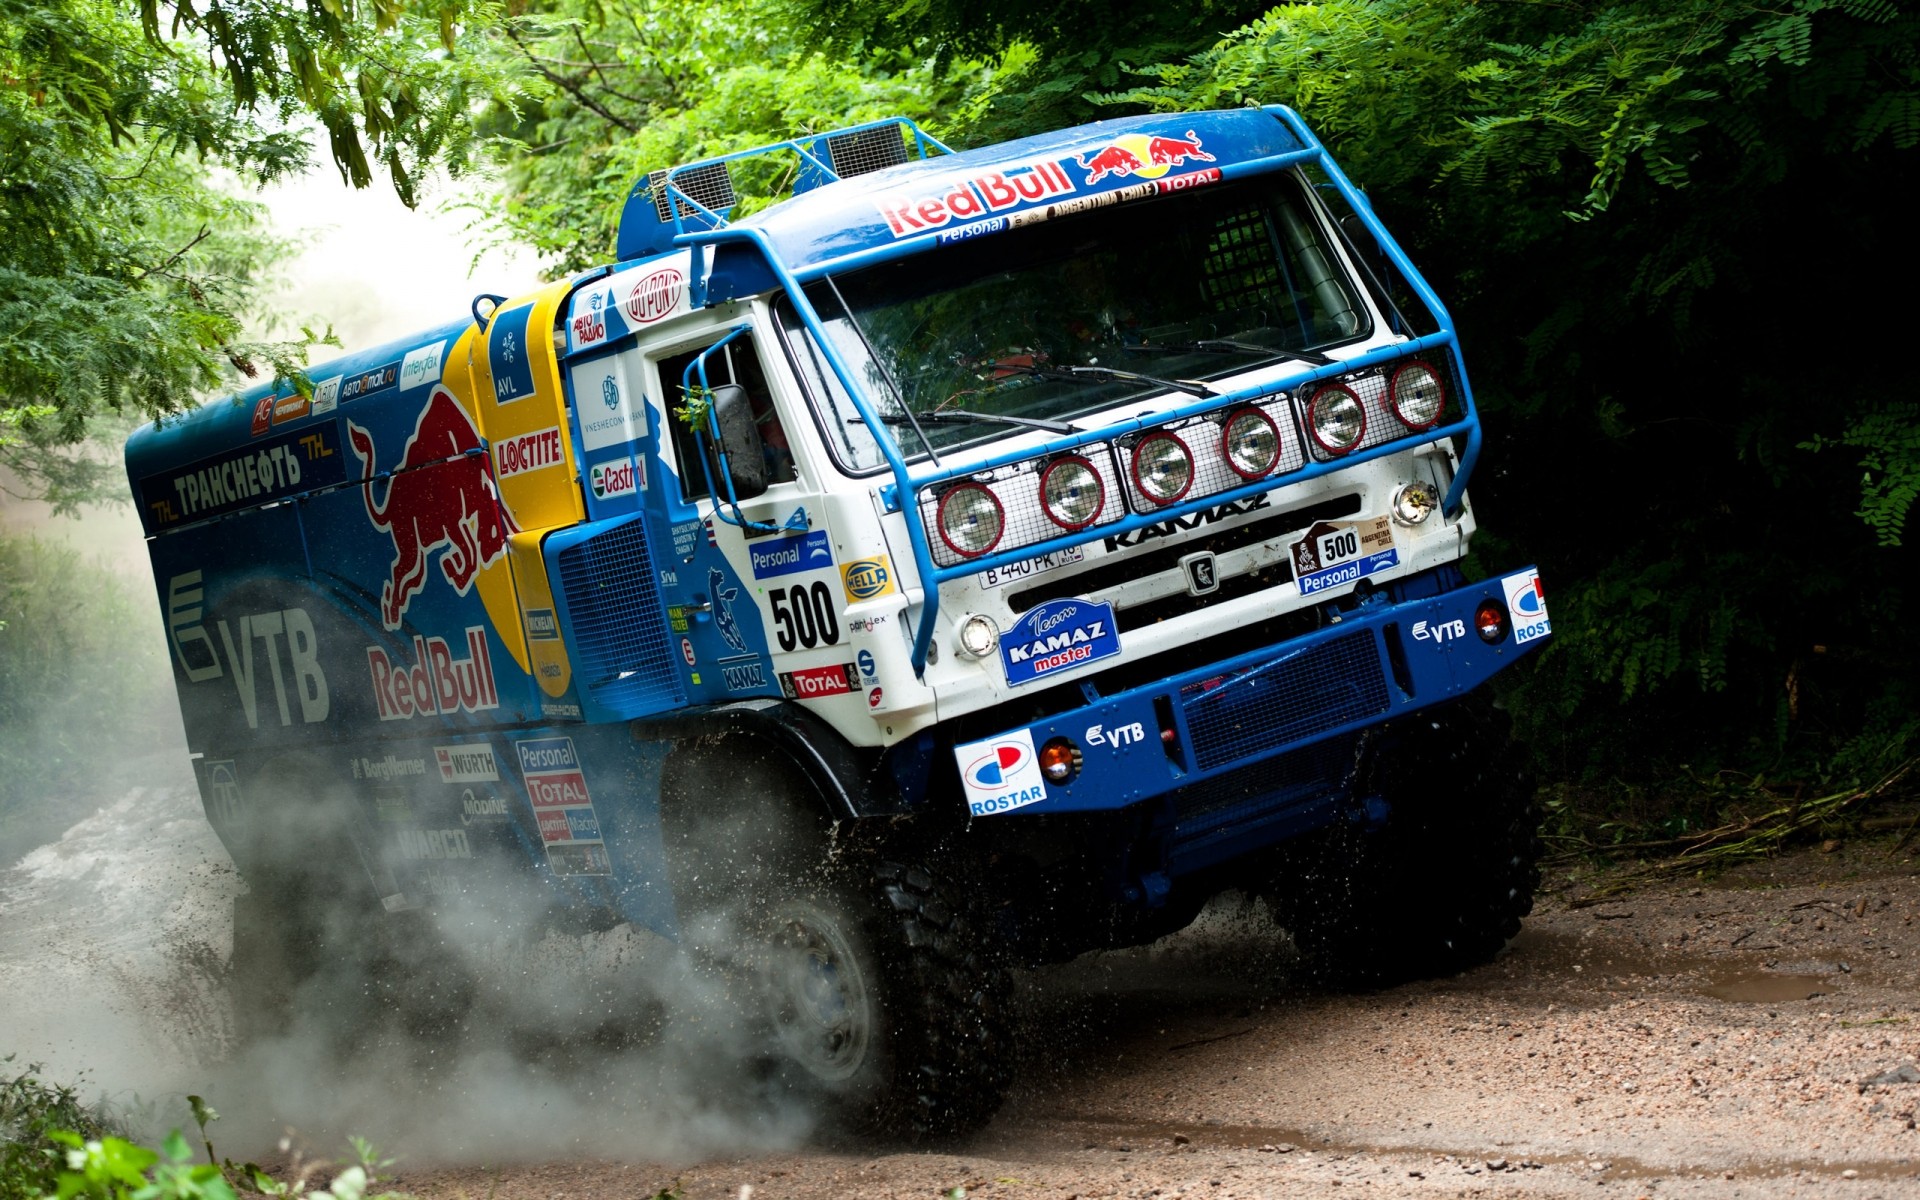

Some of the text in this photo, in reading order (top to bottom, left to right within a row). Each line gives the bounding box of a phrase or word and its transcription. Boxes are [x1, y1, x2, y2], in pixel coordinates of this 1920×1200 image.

[1165, 170, 1218, 191] TOTAL
[883, 161, 1075, 235] Red Bull
[942, 217, 1004, 243] Personal
[573, 313, 592, 331] АВТО
[579, 323, 604, 345] РАДИО
[498, 376, 517, 397] AVL
[498, 429, 560, 476] LOCTITE
[174, 445, 301, 516] ТРАНСНЕФТЬ
[1104, 493, 1271, 553] KAMAZ
[1376, 519, 1389, 530] 2011
[806, 537, 827, 548] Personal
[1324, 532, 1357, 561] 500
[1361, 529, 1391, 545] ARGENTINA
[1377, 536, 1392, 547] CHILE
[753, 544, 800, 570] Personal
[1001, 560, 1031, 579] 440
[1061, 556, 1074, 564] RUS
[1369, 550, 1392, 563] Personal
[848, 570, 888, 589] HELLA
[1303, 561, 1361, 593] Personal
[768, 580, 840, 652] 500
[1028, 606, 1077, 637] Team
[1009, 621, 1106, 664] KAMAZ
[1430, 618, 1466, 643] VTB
[683, 642, 694, 661] E
[1034, 644, 1092, 673] master
[217, 608, 330, 729] VTB
[368, 626, 499, 720] Red Bull
[722, 663, 768, 691] KAMAZ
[794, 674, 847, 694] TOTAL
[1106, 722, 1145, 748] VTB
[521, 741, 575, 769] Personal
[528, 780, 587, 804] TOTAL
[971, 785, 1042, 817] ROSTAR
[464, 798, 509, 815] MODINE
[569, 815, 597, 832] Macro
[397, 829, 472, 860] WABCO
